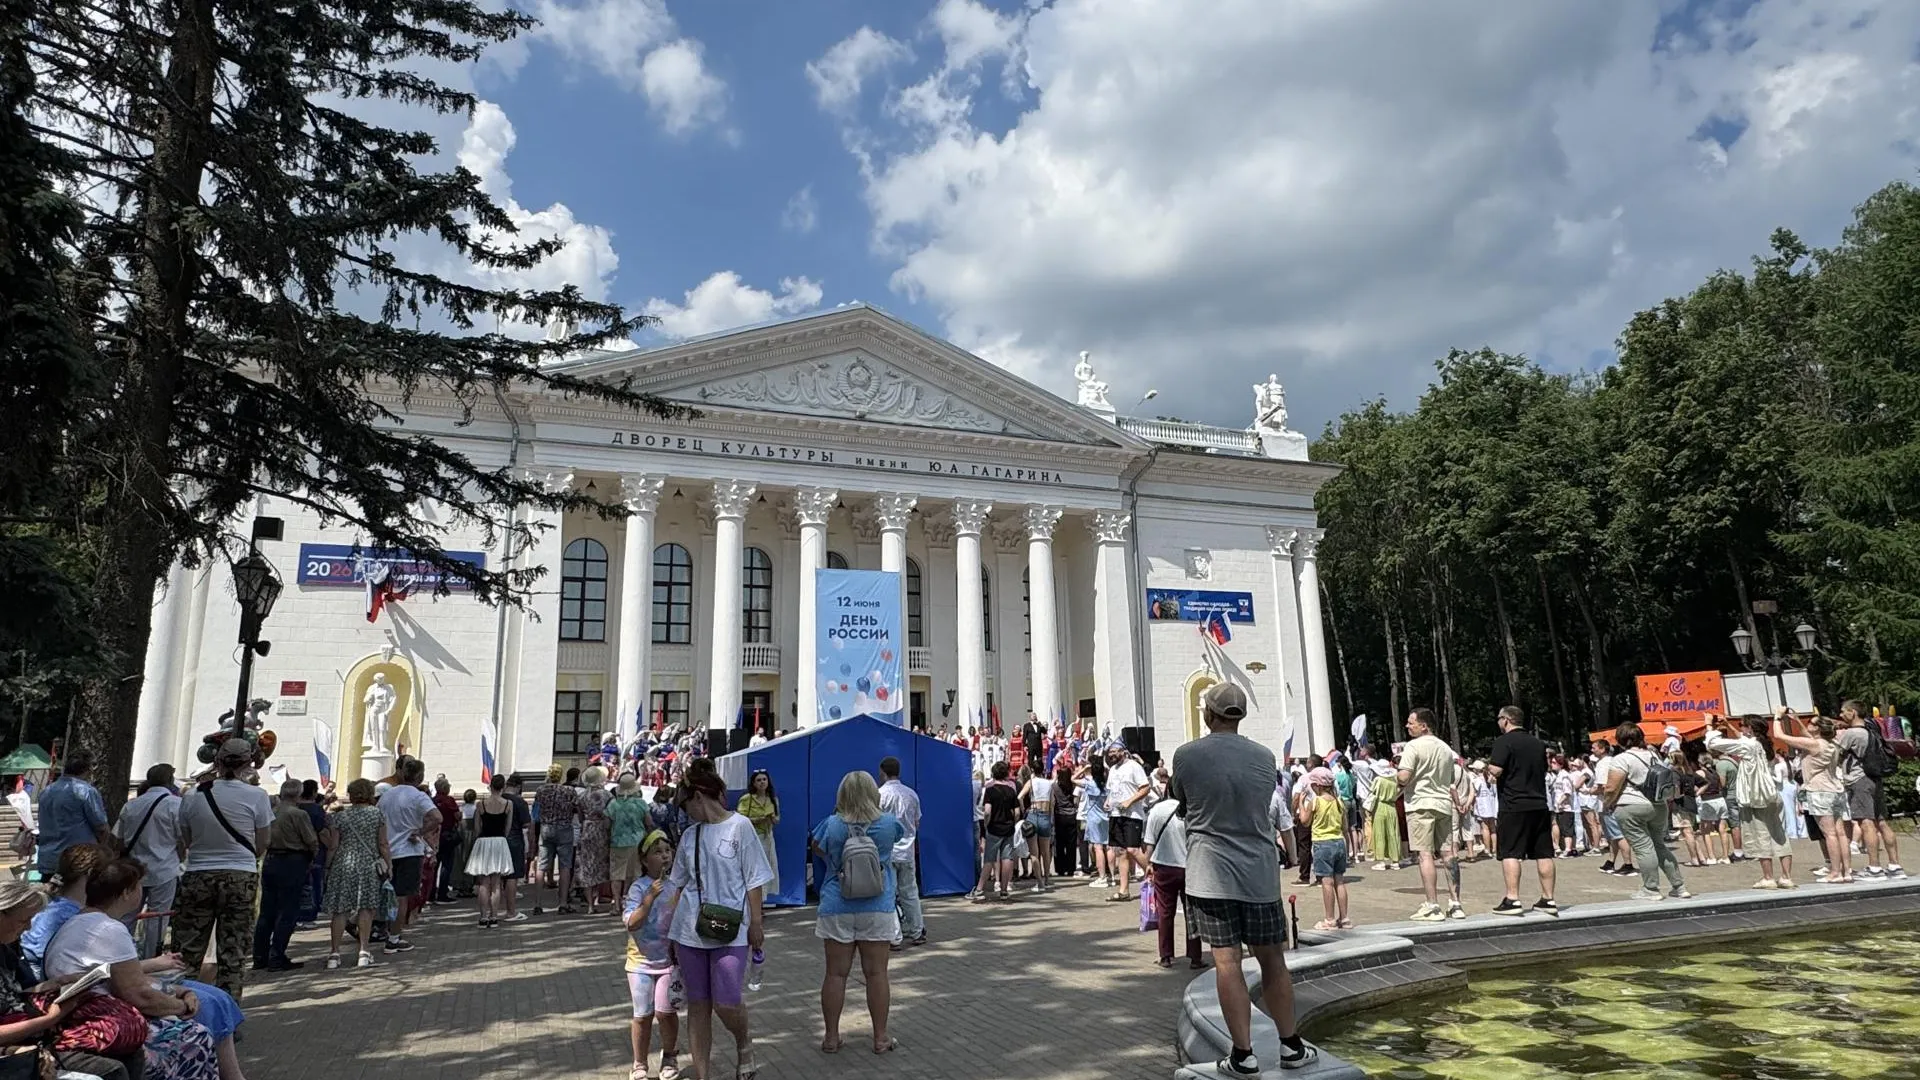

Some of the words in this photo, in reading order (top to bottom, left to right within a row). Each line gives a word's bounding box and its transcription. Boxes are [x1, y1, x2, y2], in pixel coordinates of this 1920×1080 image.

[612, 432, 703, 452] ДВОРЕЦ
[721, 442, 834, 462] КУЛЬТУРЫ
[971, 465, 1062, 483] ГАГАРИНА
[306, 561, 353, 577] 2026
[836, 596, 851, 607] 12
[840, 615, 878, 627] ДЕНЬ
[828, 628, 889, 640] РОССИИ
